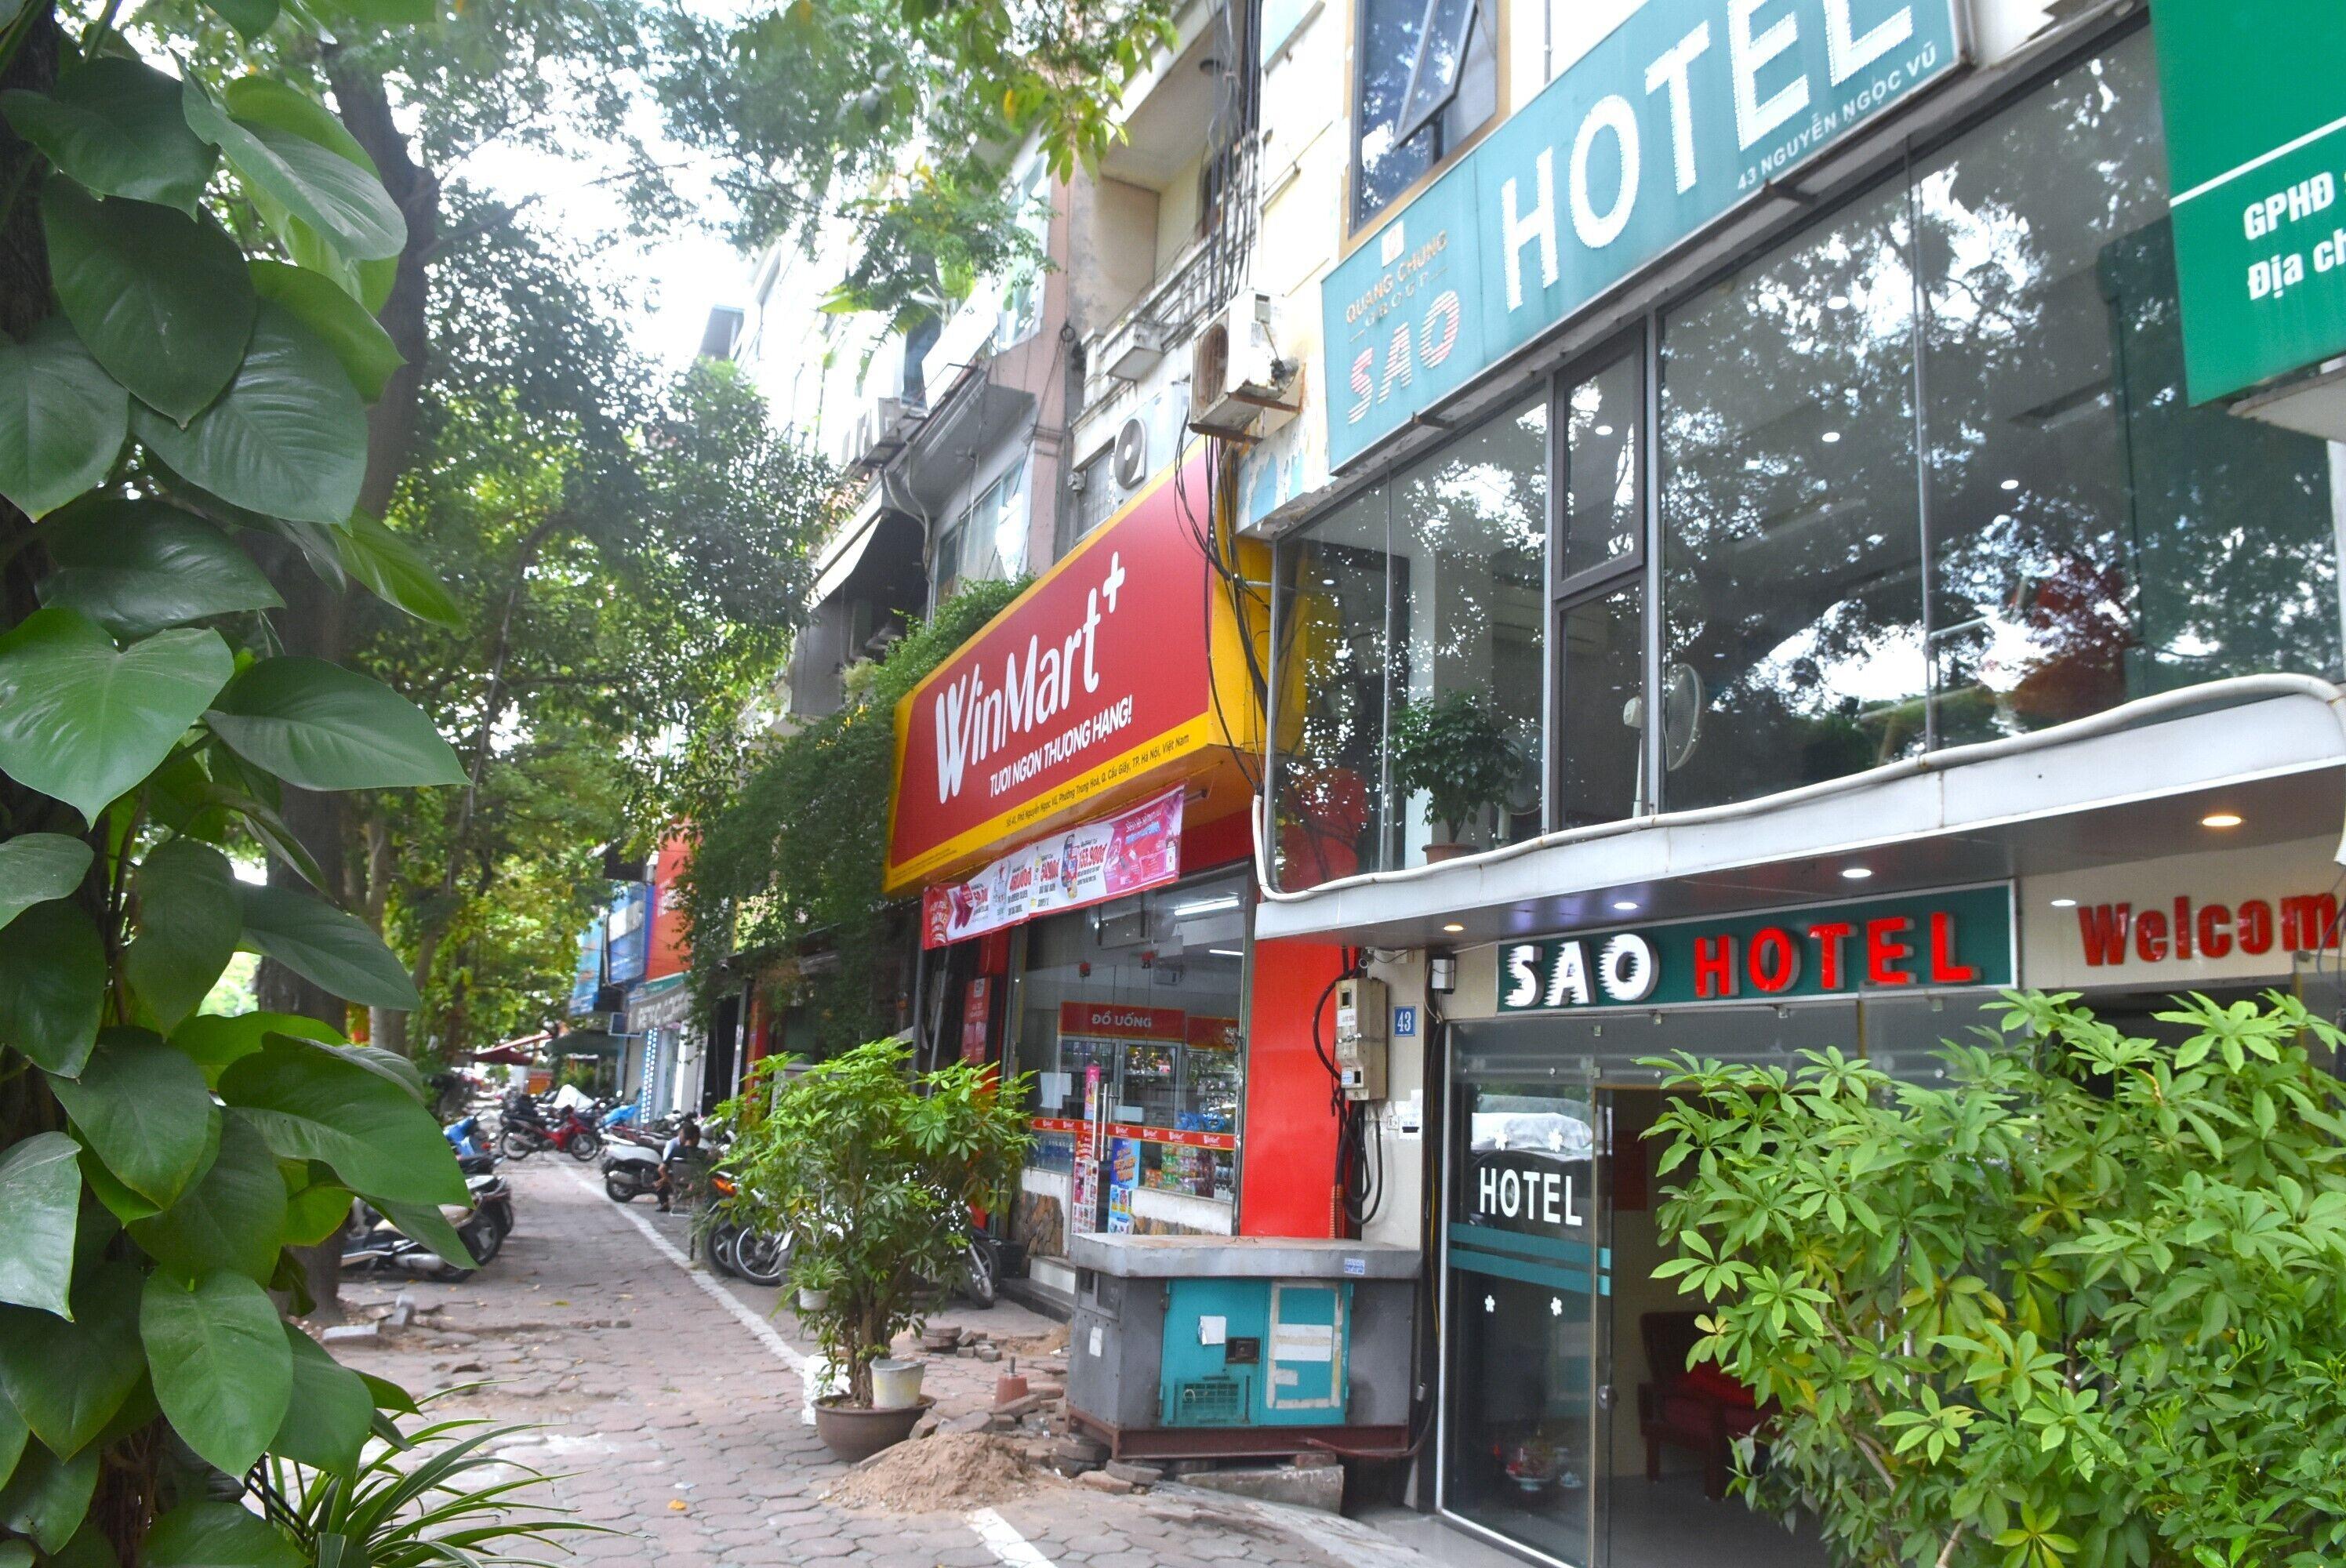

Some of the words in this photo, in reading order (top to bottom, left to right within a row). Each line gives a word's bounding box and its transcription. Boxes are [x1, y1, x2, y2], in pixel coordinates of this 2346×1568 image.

[1501, 0, 1913, 314] HOTEL
[1738, 166, 1756, 191] 43
[1760, 112, 1838, 176] NGUYỄN
[1843, 70, 1901, 122] NGỌC
[1906, 41, 1937, 78] VŨ
[2243, 171, 2336, 241] GPHĐ
[1346, 274, 1393, 323] QUANG
[1397, 229, 1448, 282] CHUNG
[2247, 252, 2304, 301] Địa
[1348, 289, 1460, 425] SAO
[1012, 746, 1043, 786] NGON
[1091, 693, 1133, 744] HẠNG!
[1175, 734, 1190, 748] Nam
[1505, 933, 1656, 1007] SAO
[1694, 911, 1977, 999] HOTEL
[2078, 892, 2341, 967] Welcom
[1396, 1010, 1412, 1033] 43
[1480, 1167, 1583, 1227] HOTEL
